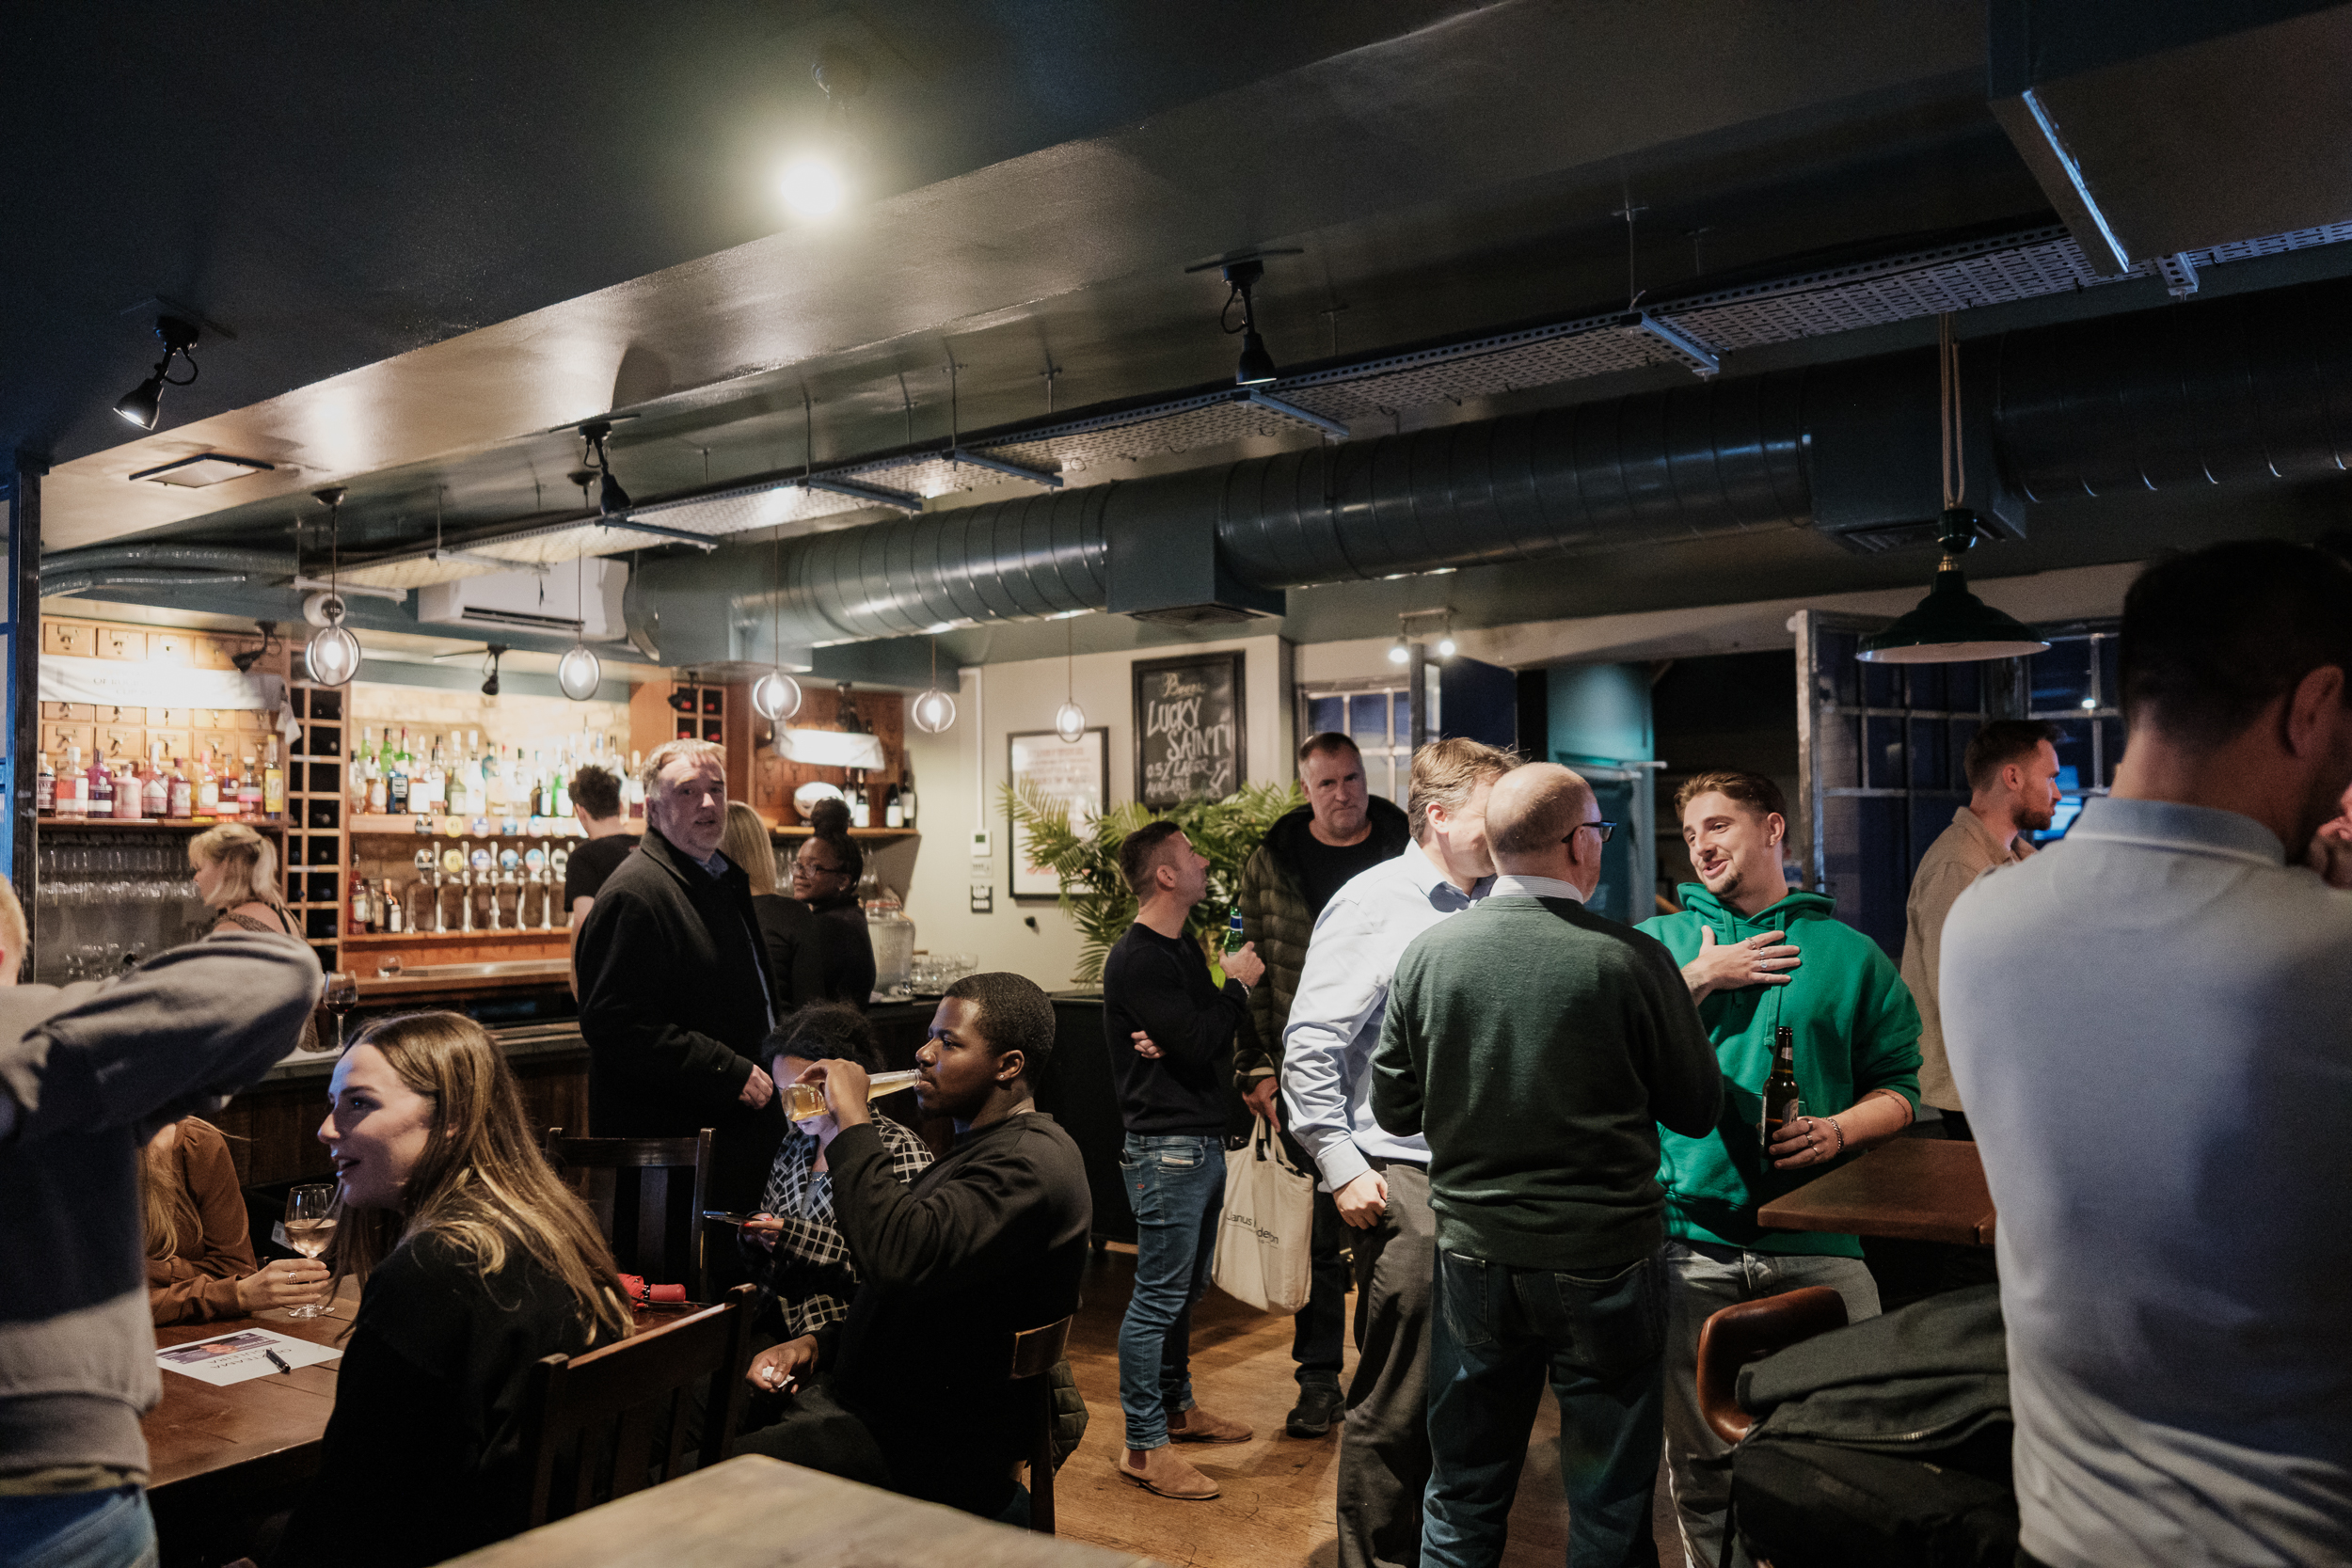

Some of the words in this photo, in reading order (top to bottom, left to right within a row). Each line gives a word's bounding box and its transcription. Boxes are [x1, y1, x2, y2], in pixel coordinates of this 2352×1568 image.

[1148, 697, 1202, 737] LUCKY
[1173, 759, 1212, 777] LAGER
[1227, 1211, 1252, 1227] Janus
